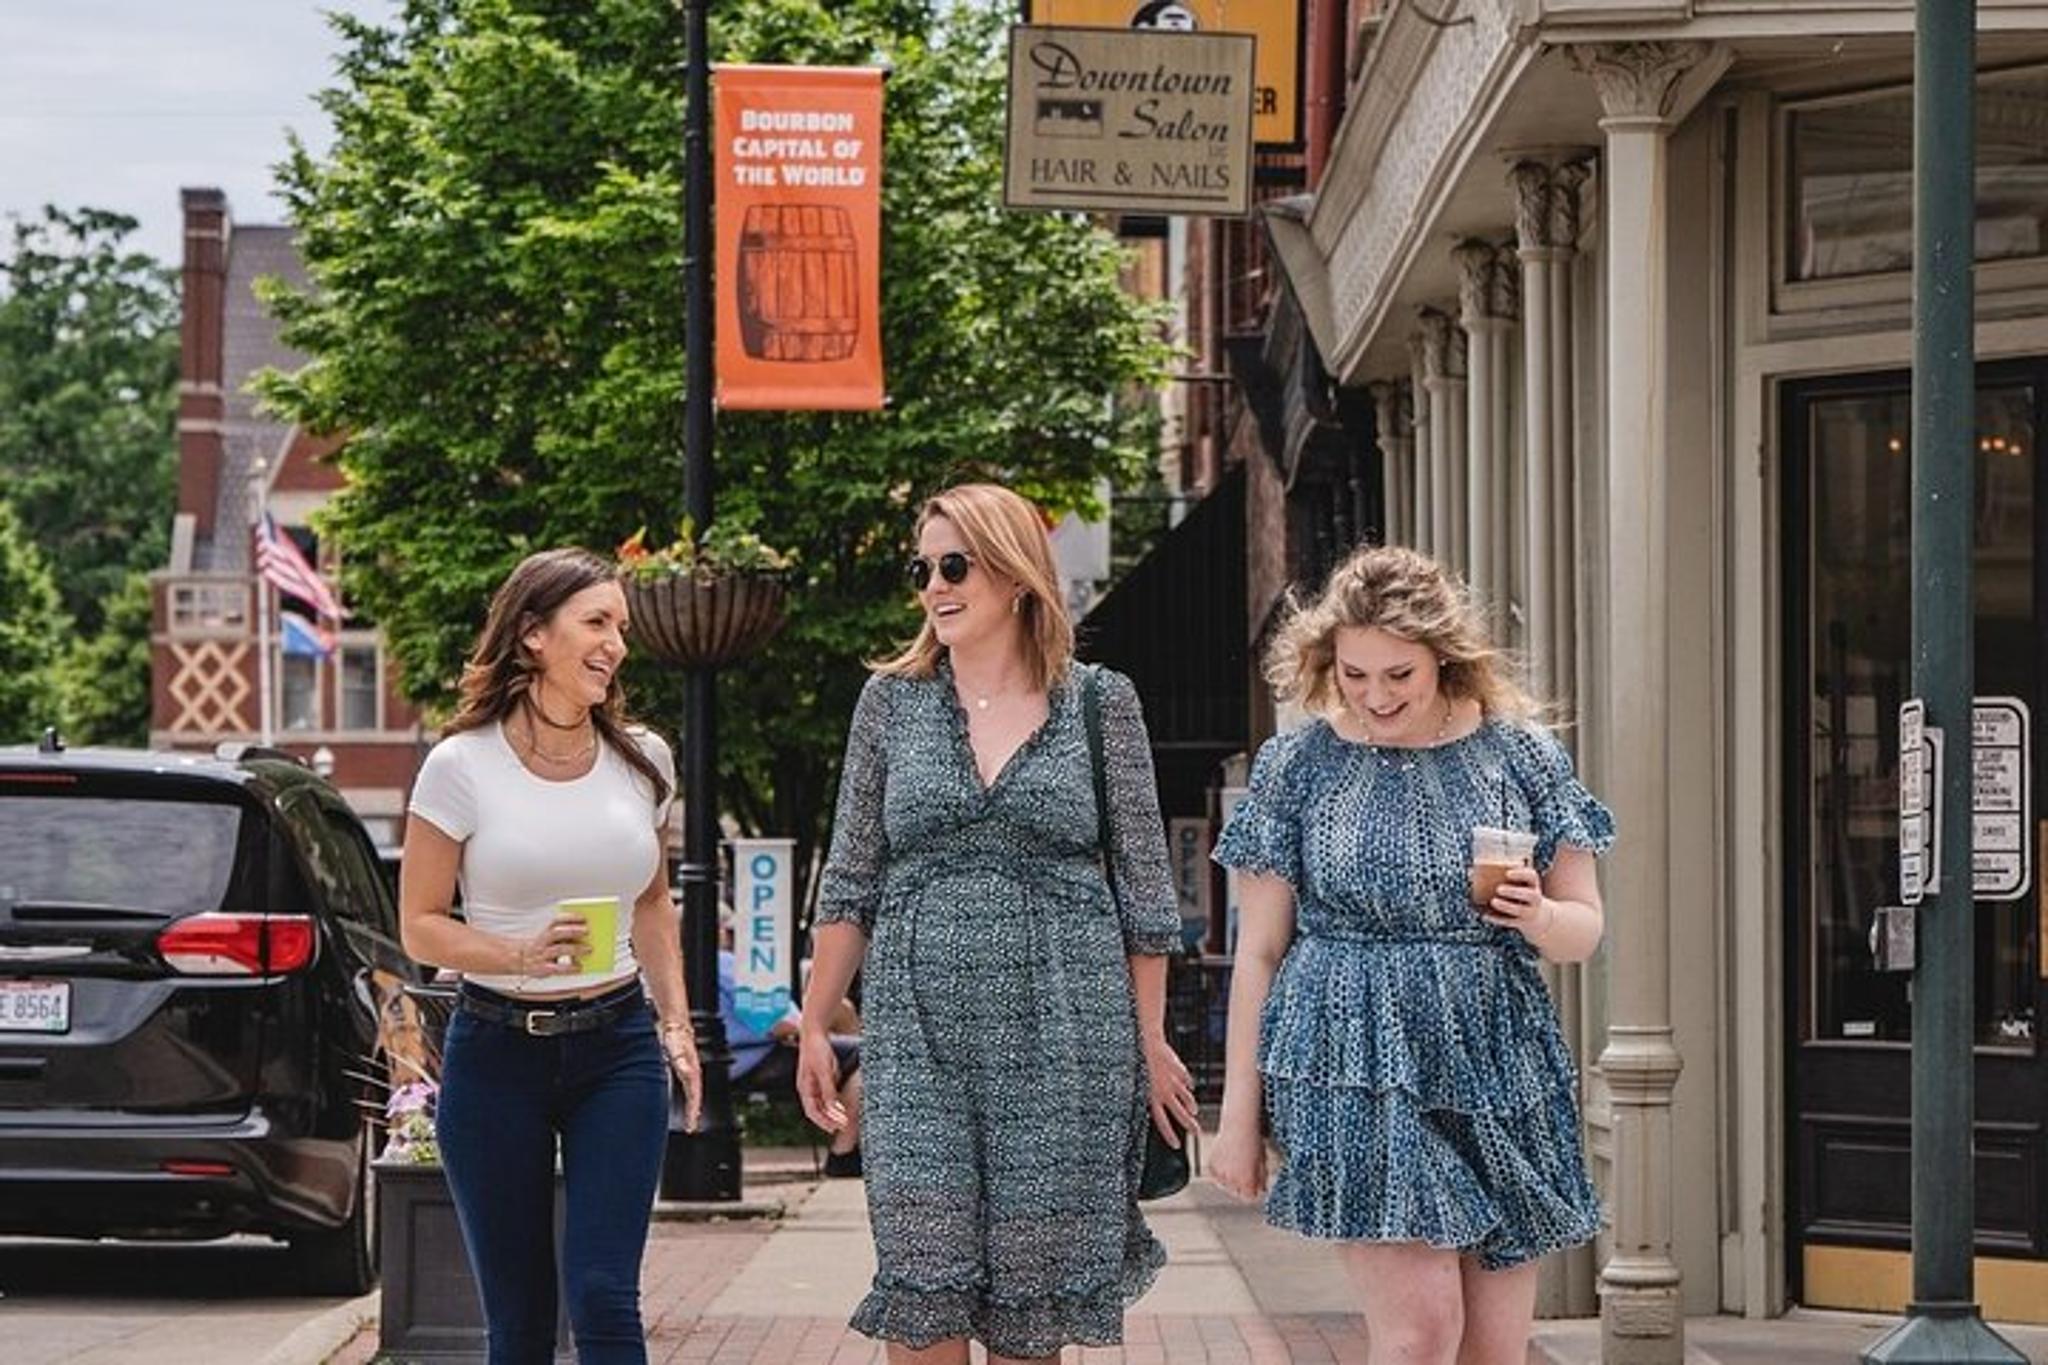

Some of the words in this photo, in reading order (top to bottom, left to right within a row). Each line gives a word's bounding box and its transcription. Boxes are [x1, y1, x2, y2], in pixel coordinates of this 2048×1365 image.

[1029, 41, 1232, 94] Downtown
[741, 110, 854, 132] BOURBON
[1117, 100, 1228, 142] Salon
[732, 137, 827, 159] CAPITAL
[832, 140, 863, 159] OF
[733, 164, 777, 185] THE
[781, 164, 867, 186] WORLD
[1031, 158, 1097, 183] HAIR
[1113, 161, 1133, 185] &
[1151, 163, 1231, 189] NAILS
[751, 854, 777, 973] OPEN
